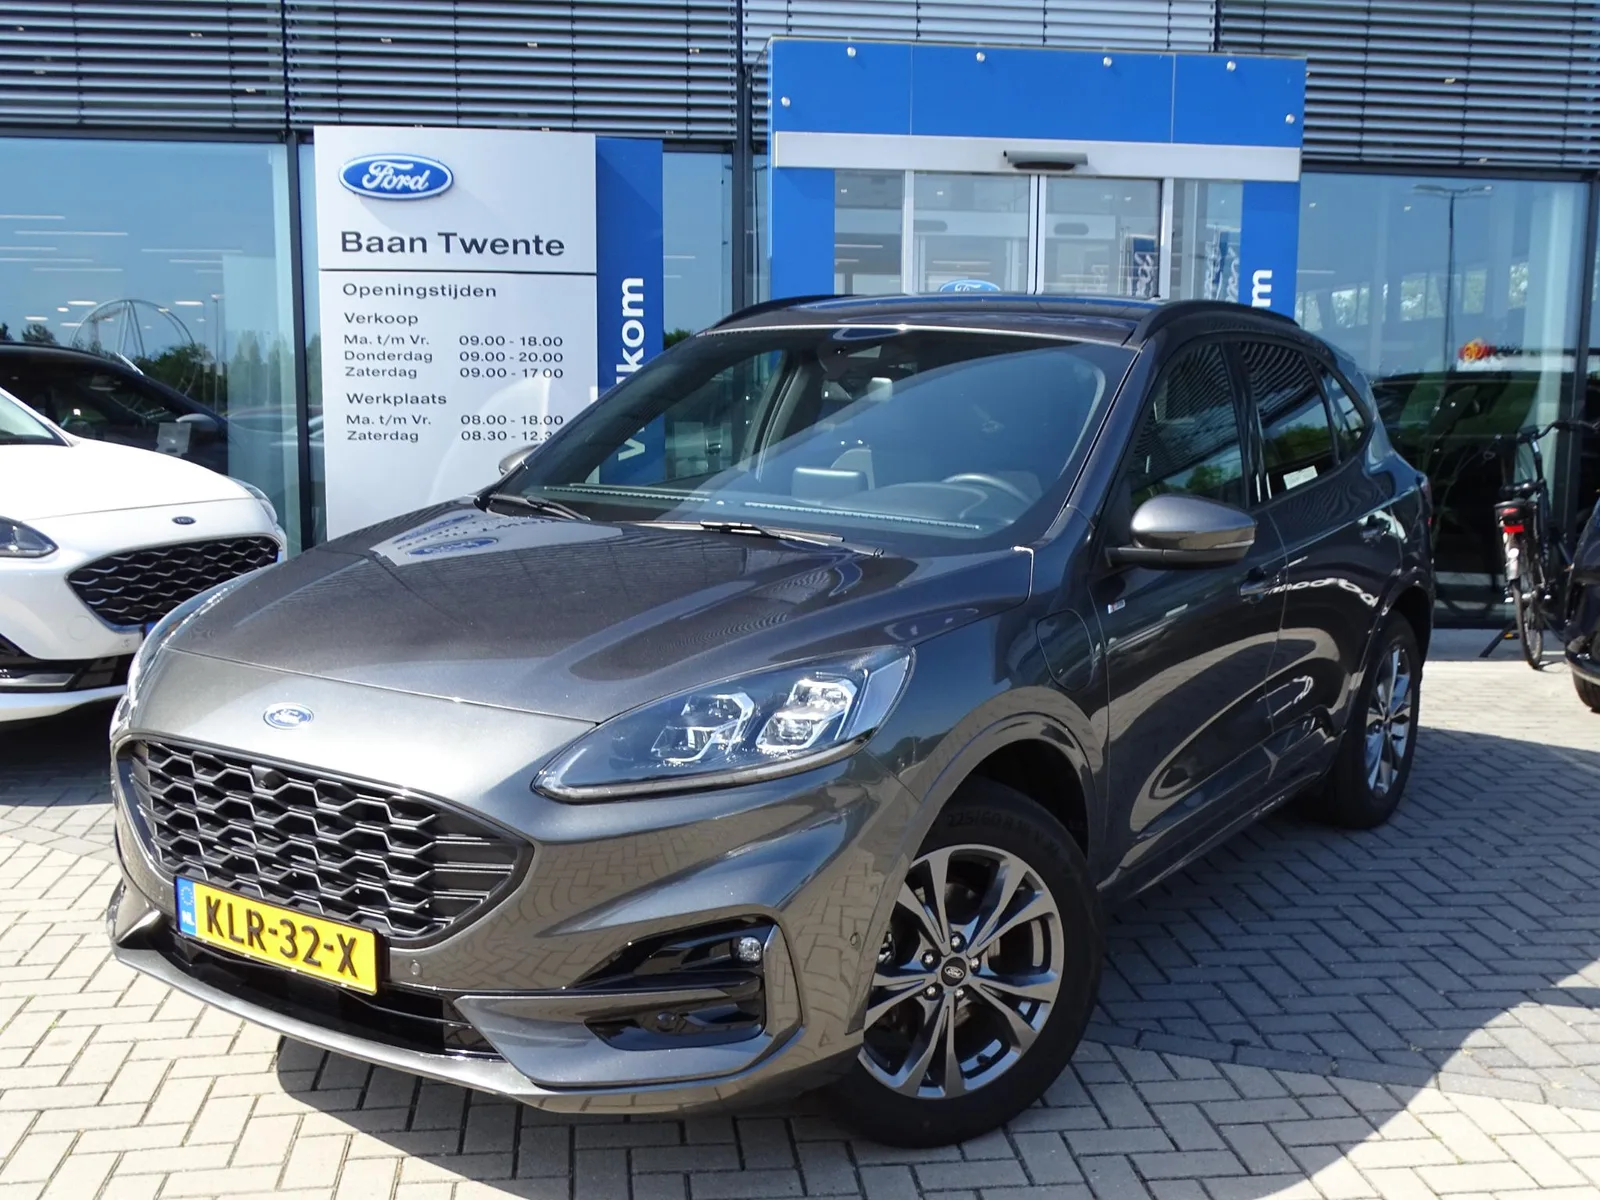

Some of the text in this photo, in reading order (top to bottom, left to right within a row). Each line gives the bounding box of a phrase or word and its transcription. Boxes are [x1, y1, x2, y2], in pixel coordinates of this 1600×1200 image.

[361, 160, 431, 192] Ford
[340, 231, 565, 257] Baan Twente
[343, 283, 497, 300] Openingstijden
[344, 312, 419, 327] Verkoop
[344, 334, 372, 345] Ma.
[377, 334, 405, 346] t/m
[410, 334, 430, 345] Vr.
[459, 335, 505, 346] 09.00
[520, 336, 563, 347] 18.00
[344, 350, 433, 364] Donderdag
[459, 351, 505, 362] 09.00
[518, 352, 563, 363] 20.00
[345, 366, 417, 379] Zaterdag
[459, 367, 507, 378] 09.00
[521, 368, 563, 379] 1700
[345, 392, 447, 407] Werkplaats
[346, 414, 374, 425] Ma.
[379, 414, 407, 426] t/m
[412, 414, 431, 425] Vr.
[460, 414, 507, 425] 08.00
[520, 415, 564, 426] 18.00
[347, 430, 419, 443] Zaterdag
[461, 430, 507, 441] 08.30
[521, 430, 553, 441] 12.3
[182, 910, 196, 926] NL
[205, 895, 358, 978] KLR-32-X
